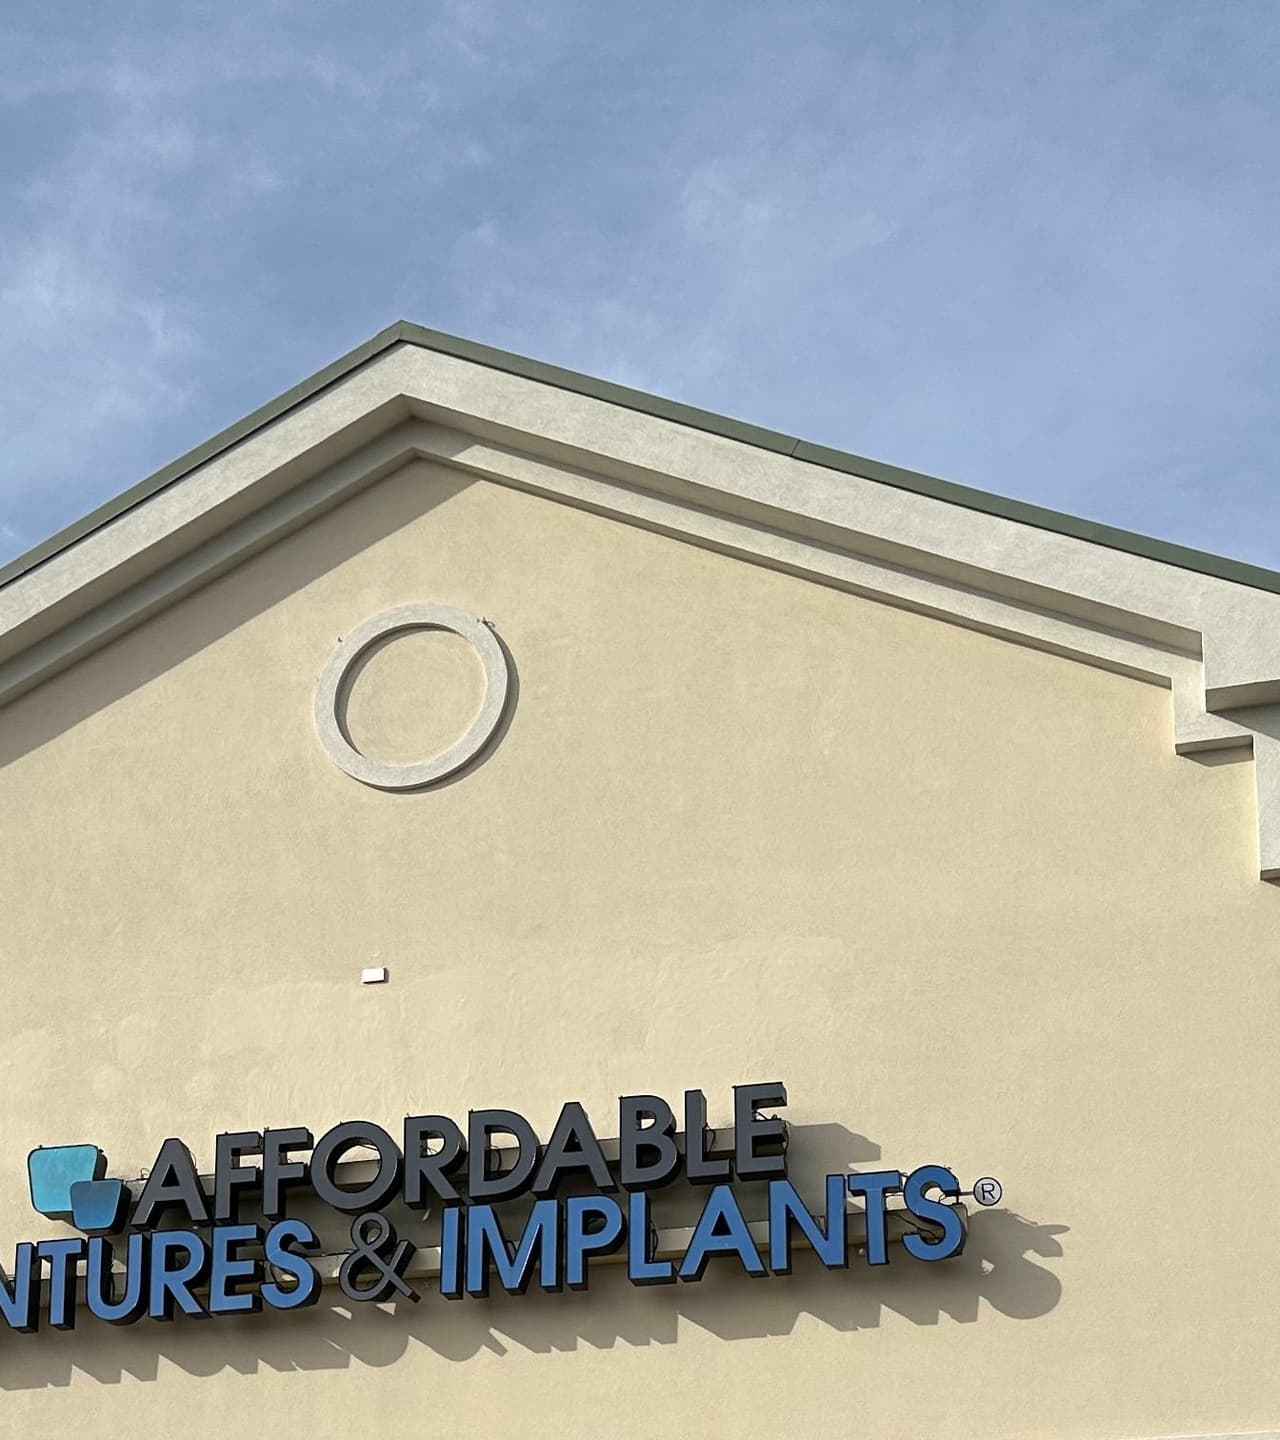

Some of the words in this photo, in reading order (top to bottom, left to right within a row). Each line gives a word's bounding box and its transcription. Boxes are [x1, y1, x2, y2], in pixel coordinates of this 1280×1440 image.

[130, 1081, 788, 1232] AFFORDABLE
[338, 1212, 420, 1303] &
[438, 1164, 968, 1299] IMPLANTS
